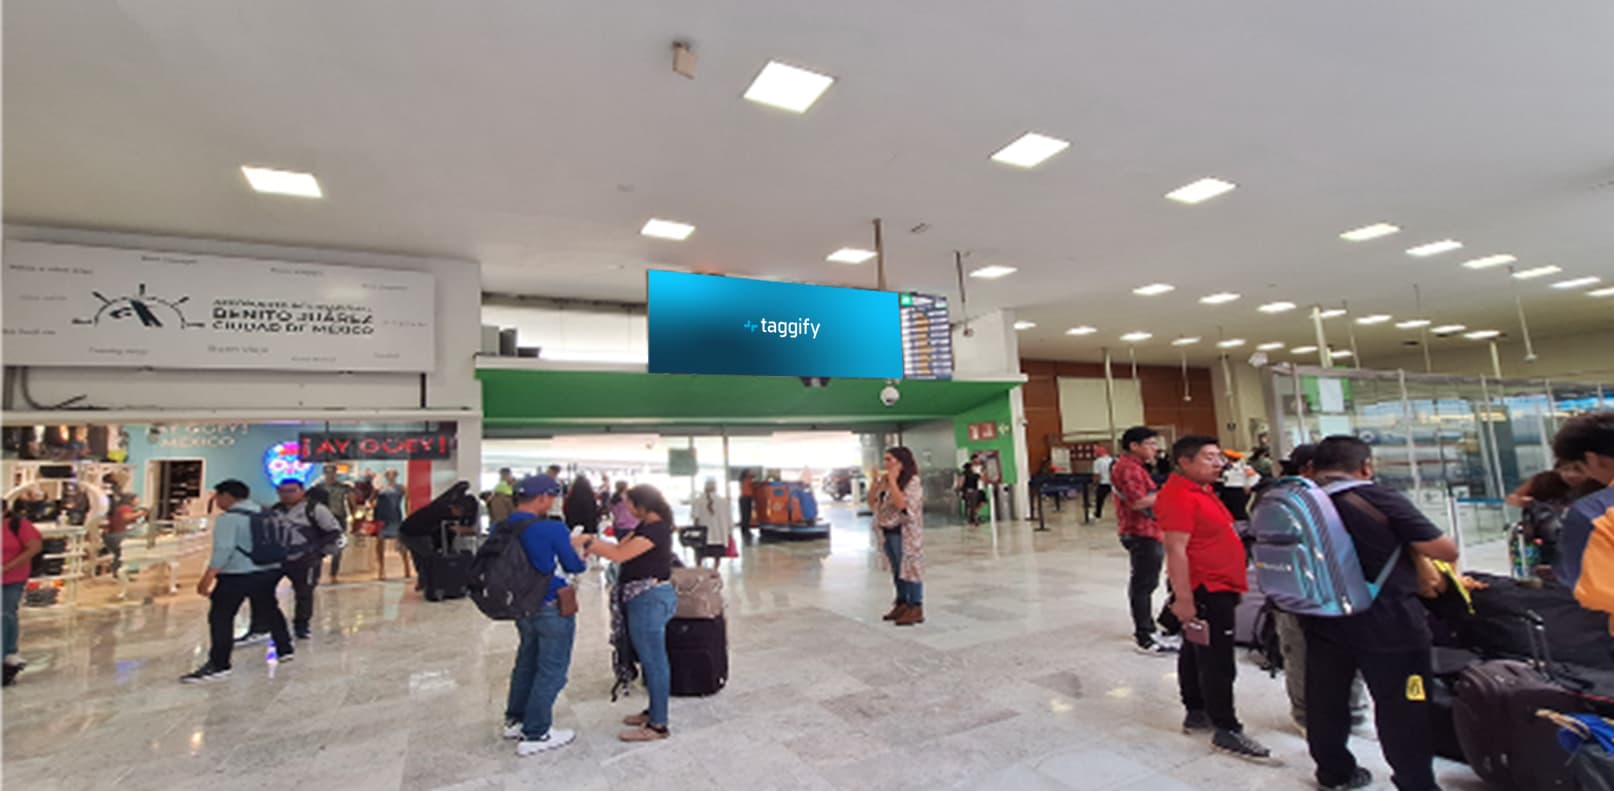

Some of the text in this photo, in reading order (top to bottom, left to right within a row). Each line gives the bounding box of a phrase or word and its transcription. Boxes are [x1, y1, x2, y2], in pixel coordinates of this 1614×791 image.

[213, 307, 292, 322] BENITO
[212, 320, 281, 332] CIUDAD
[285, 322, 306, 332] DE
[760, 317, 821, 339] taggify
